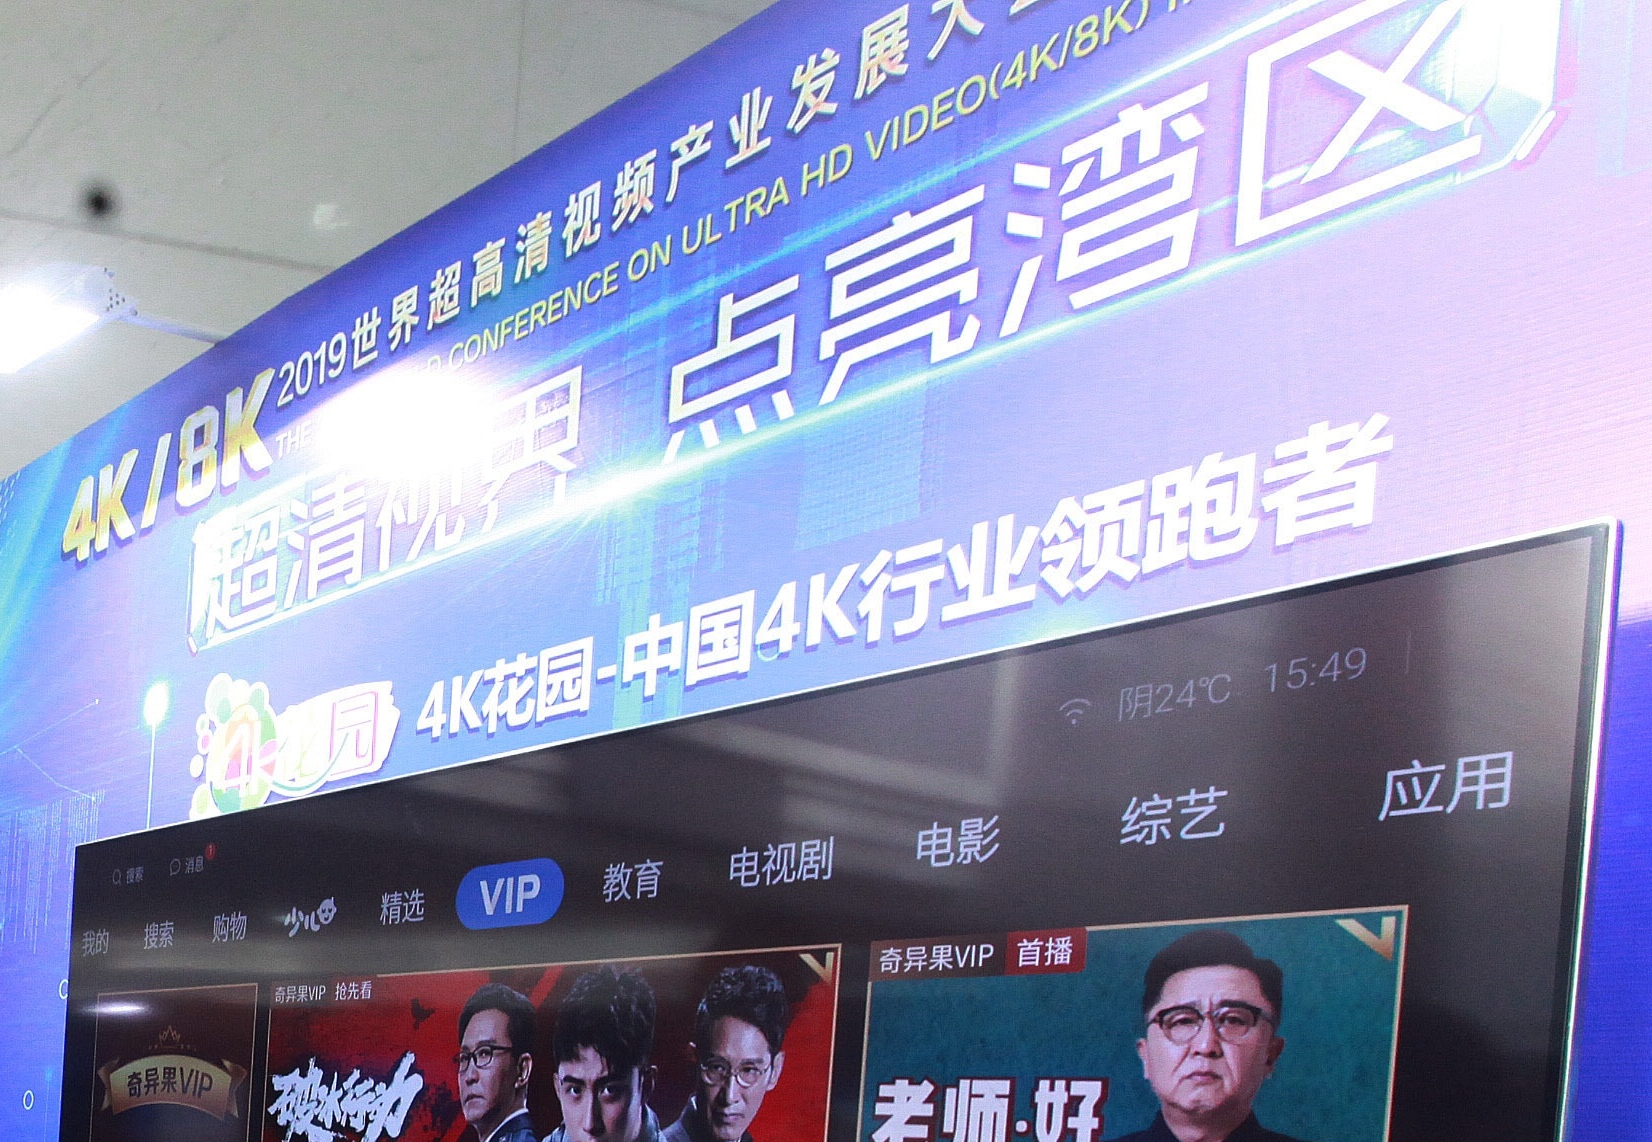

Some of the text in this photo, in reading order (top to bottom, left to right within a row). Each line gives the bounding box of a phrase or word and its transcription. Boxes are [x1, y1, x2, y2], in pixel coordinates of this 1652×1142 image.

[277, 0, 1030, 408] 2019世界超高清视频产业发展大
[448, 260, 621, 371] CONFERENCE
[627, 245, 672, 282] ON
[682, 177, 791, 256] ULTRA
[801, 142, 853, 195] HD
[662, 0, 1482, 463] 点亮湾区
[60, 366, 275, 562] 4K/8K
[415, 413, 1394, 740] 4K花园-中国4K行业领跑者
[1263, 646, 1368, 694] 15:49
[82, 750, 1514, 957] 我的 搜索 购物 少儿 精选 VIP 教育 电视剧 电影 综艺 应用
[185, 855, 204, 874] 消息
[274, 980, 373, 1004] 奇异果VIP 抢先看
[878, 936, 1074, 974] 奇异果VIP 首播
[126, 1065, 214, 1099] 奇异果VIP
